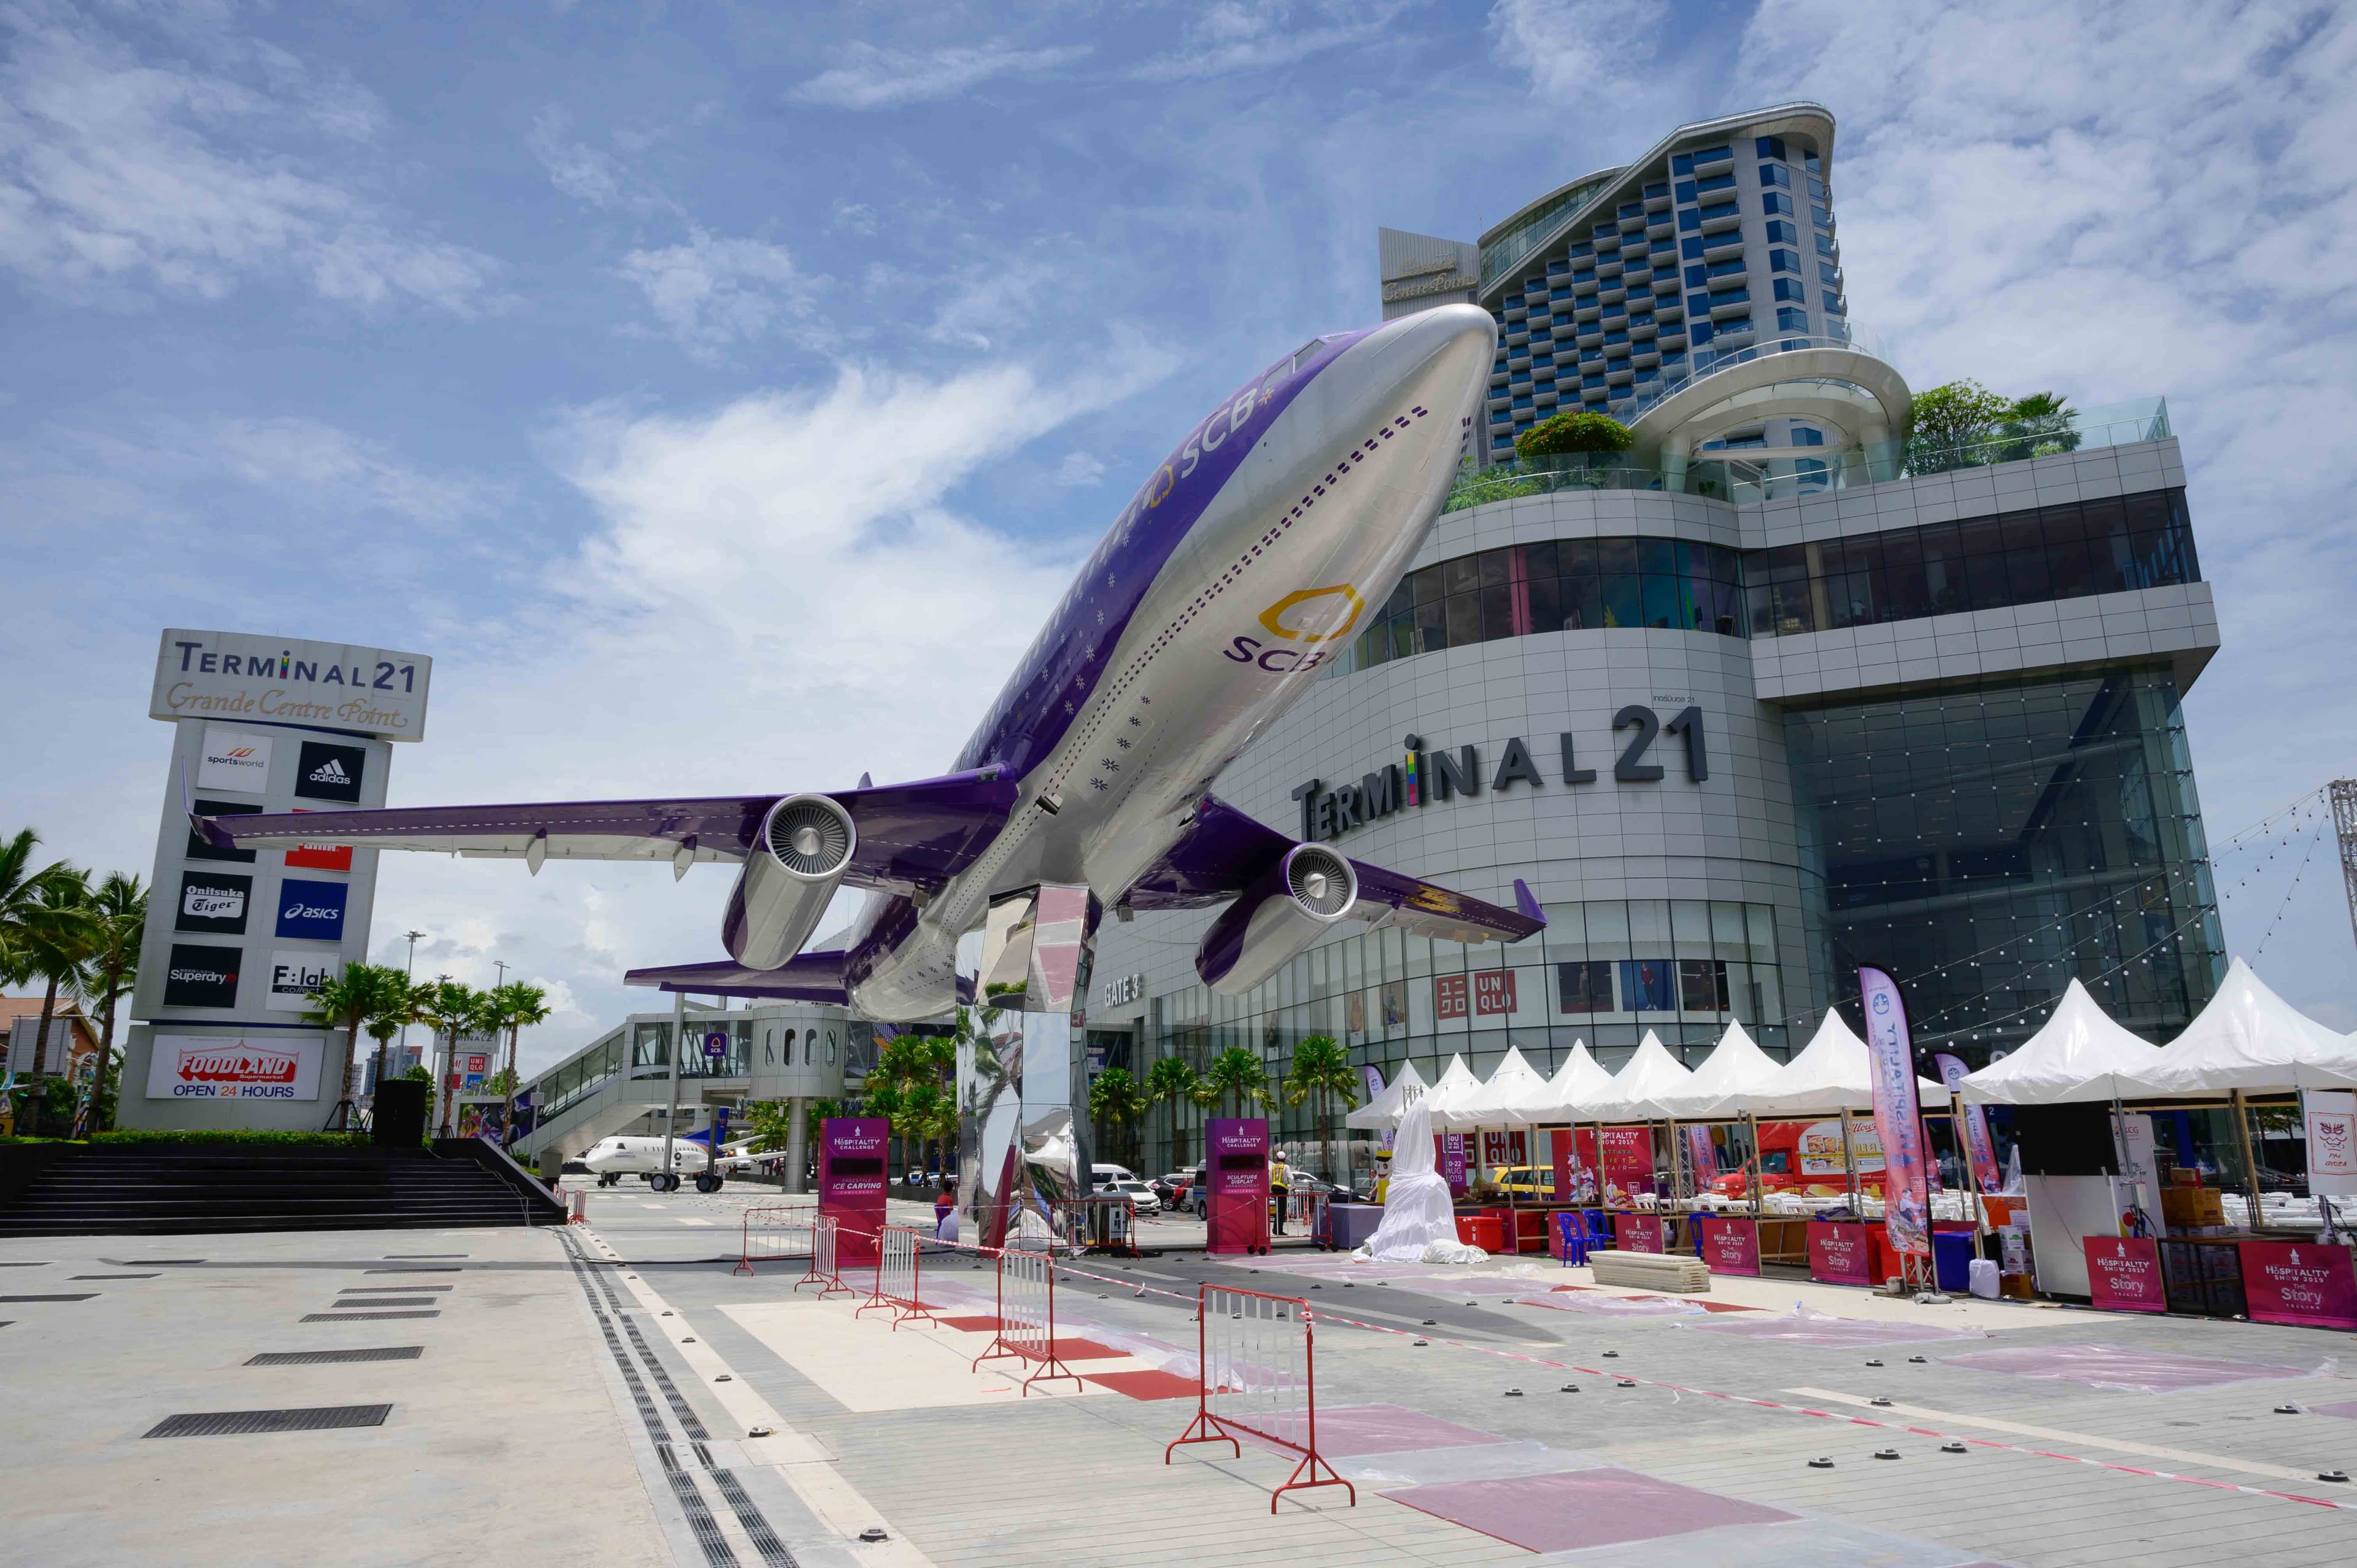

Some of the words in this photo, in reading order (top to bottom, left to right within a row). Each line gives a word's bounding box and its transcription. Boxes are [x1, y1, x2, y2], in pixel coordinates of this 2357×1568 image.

[1382, 282, 1428, 301] Centre
[1430, 272, 1479, 292] Point
[1181, 388, 1257, 479] SCB
[1223, 636, 1326, 673] SCB
[167, 682, 255, 713] Grande
[258, 689, 333, 719] Centre
[338, 698, 409, 727] Point
[207, 755, 264, 768] sportsworld
[309, 773, 350, 785] adidas
[187, 886, 244, 898] Onitsuka
[192, 898, 236, 911] Tiger
[303, 908, 339, 919] asics
[170, 969, 226, 984] Superdry
[1105, 976, 1129, 1007] GATE
[1132, 973, 1139, 999] 3
[179, 1056, 290, 1074] FOODLAND
[174, 1085, 216, 1096] OPEN
[220, 1086, 237, 1096] 24
[242, 1086, 294, 1097] HOURS
[1989, 1106, 1995, 1115] 2
[1631, 1243, 1649, 1253] Story
[1721, 1249, 1741, 1261] Story
[1828, 1256, 1850, 1268] Story
[2110, 1278, 2144, 1293] Story
[2281, 1288, 2321, 1305] Story
